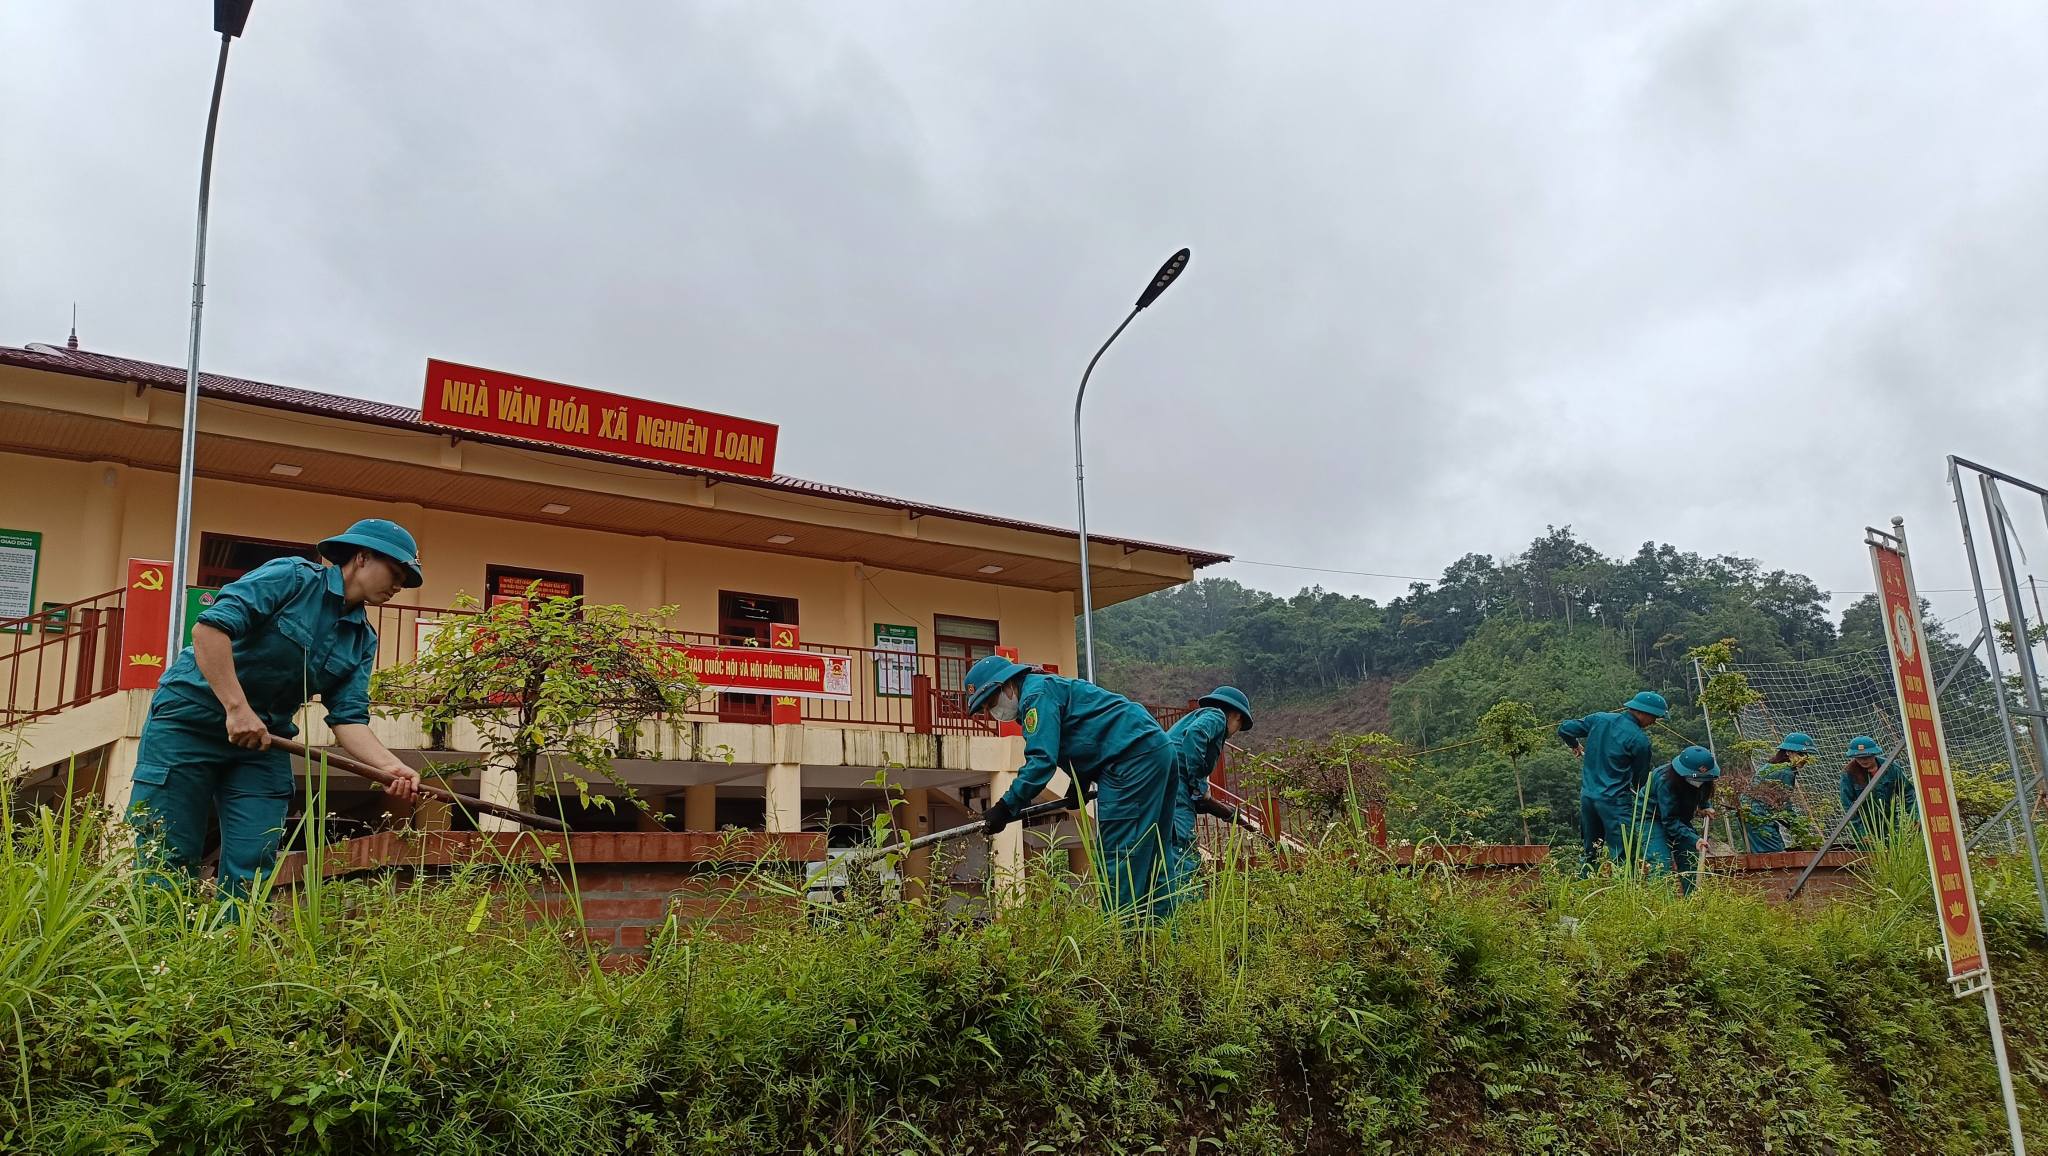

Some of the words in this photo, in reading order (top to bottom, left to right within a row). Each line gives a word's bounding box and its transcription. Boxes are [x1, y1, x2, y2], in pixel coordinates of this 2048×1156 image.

[441, 379, 489, 418] NHÀ
[498, 385, 542, 426] VĂN
[547, 396, 590, 434] HÓA
[598, 406, 628, 442] XÃ
[635, 418, 708, 456] NGHIÊN
[714, 429, 764, 465] LOAN
[705, 656, 724, 676] QUỐC
[726, 659, 737, 679] HỘI
[740, 660, 748, 676] VÀ
[750, 660, 762, 680] HỘI
[784, 664, 802, 680] NHÂN
[804, 665, 820, 682] DÂN!
